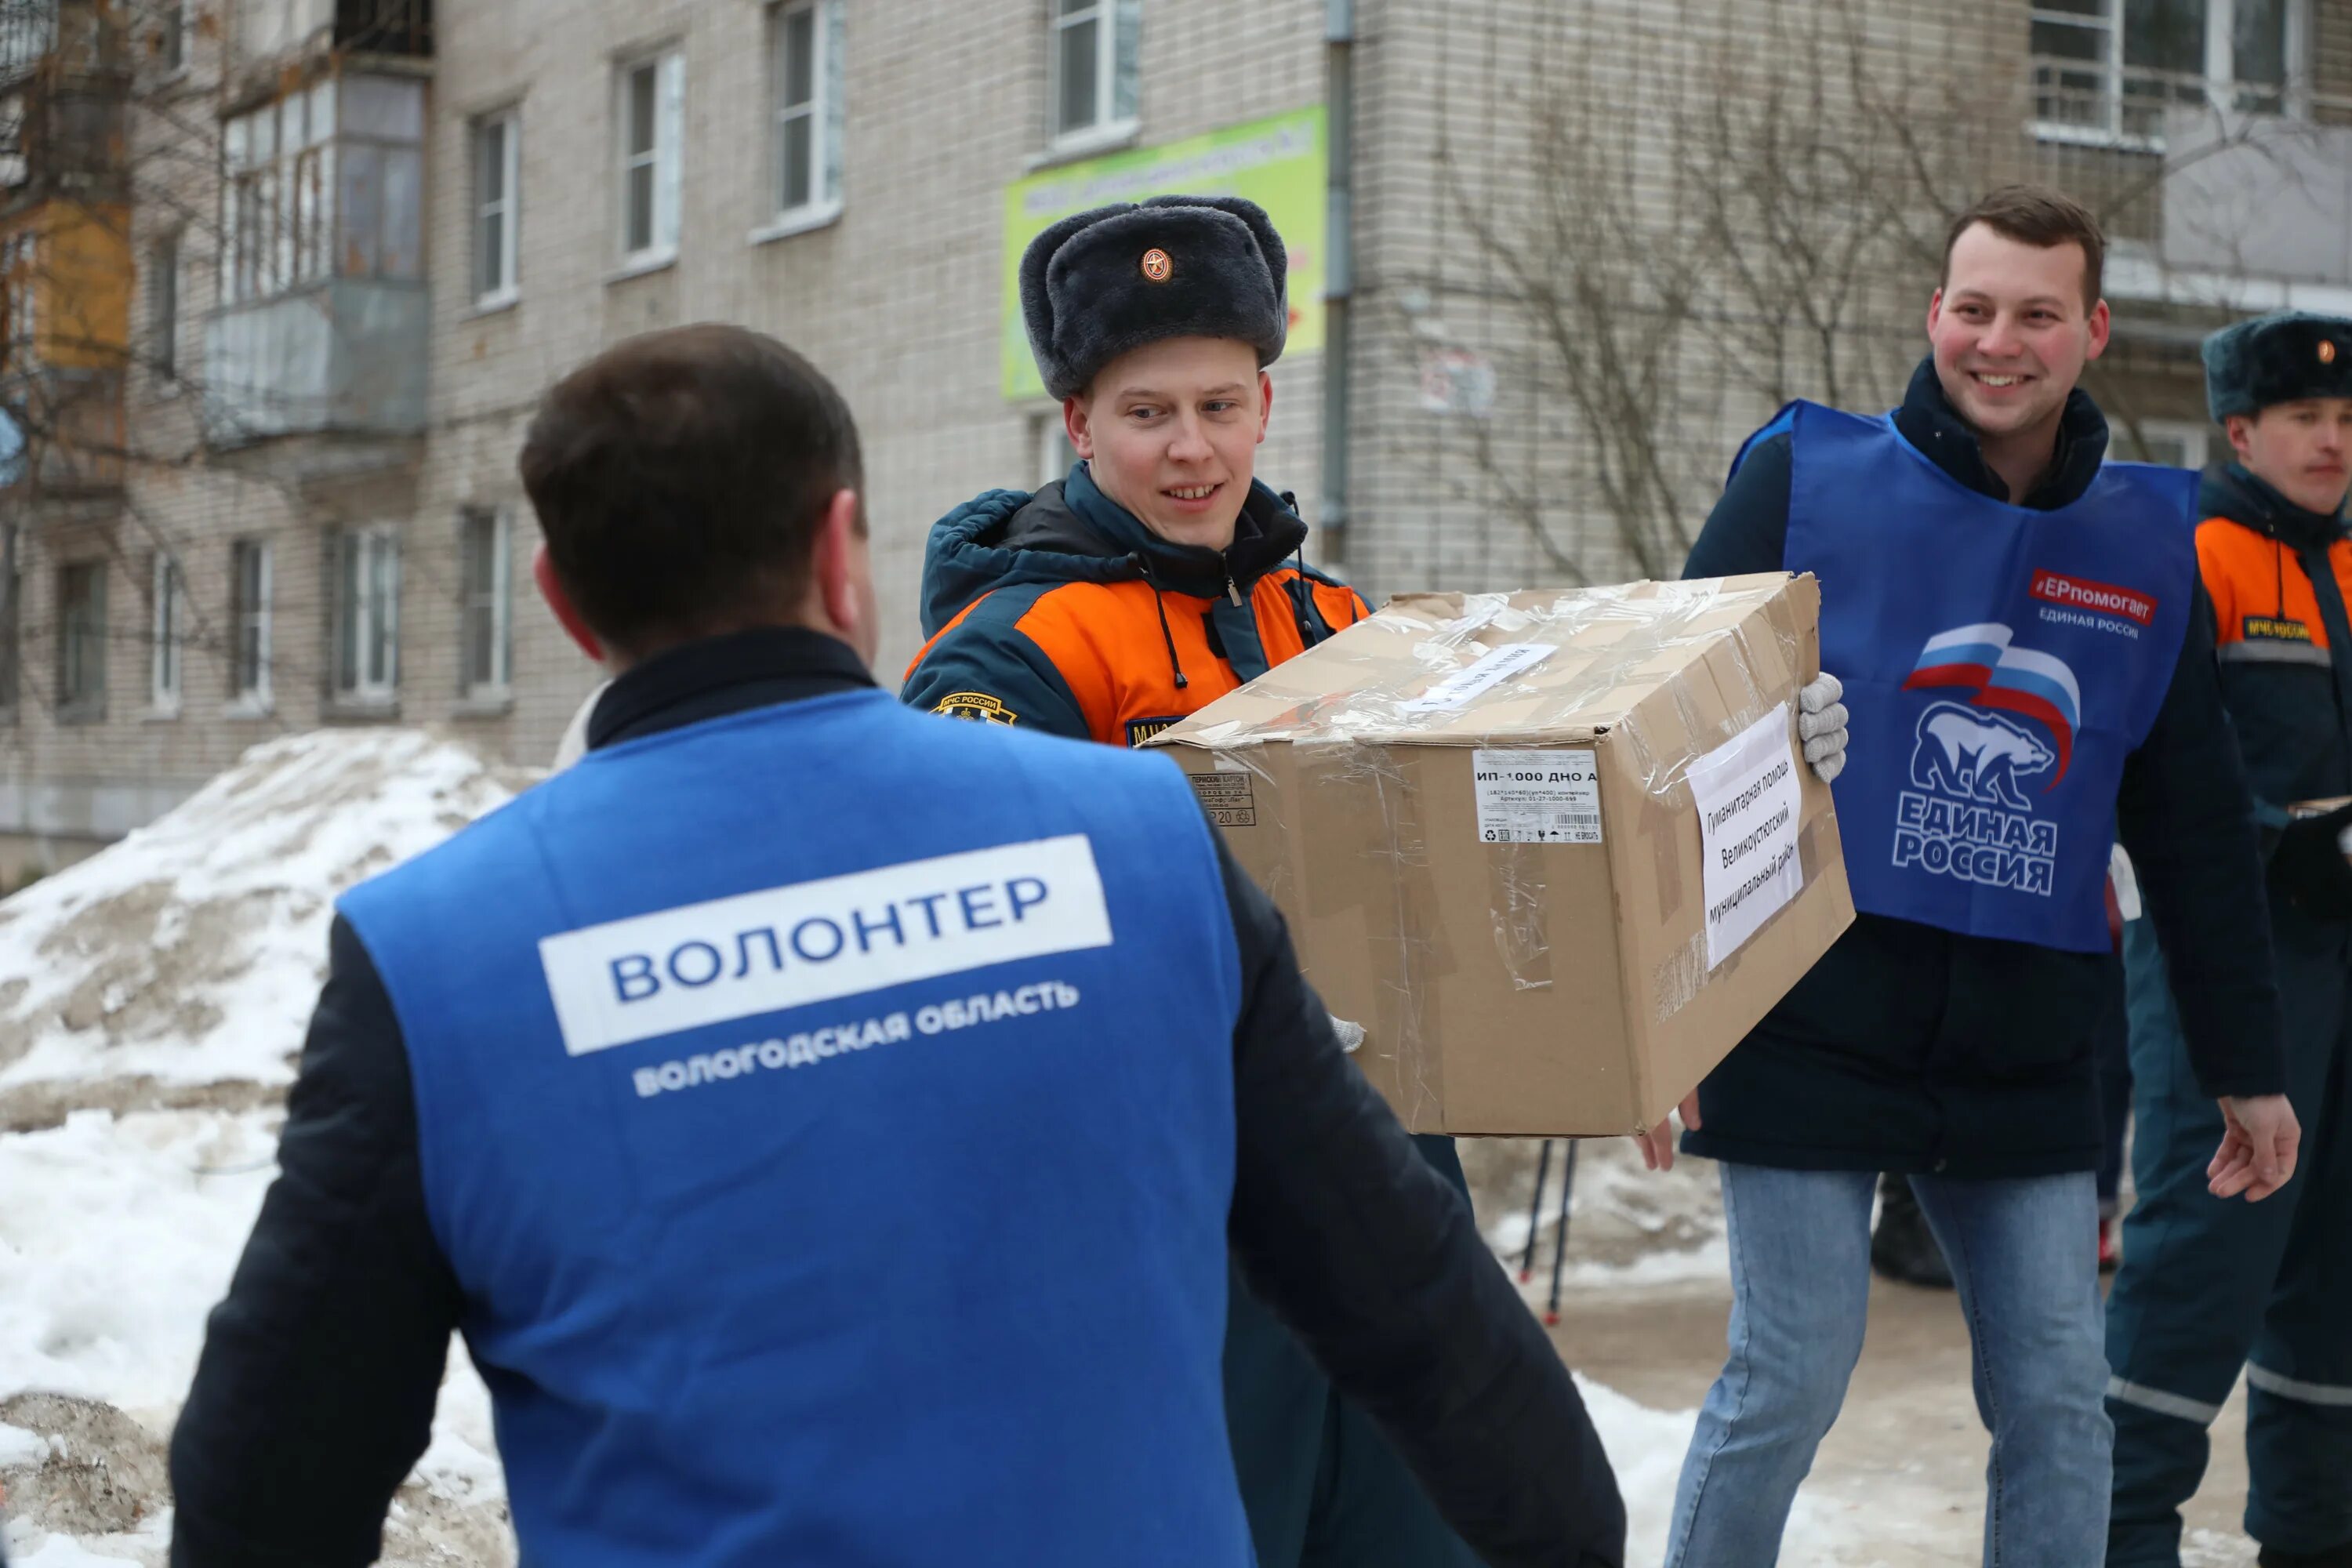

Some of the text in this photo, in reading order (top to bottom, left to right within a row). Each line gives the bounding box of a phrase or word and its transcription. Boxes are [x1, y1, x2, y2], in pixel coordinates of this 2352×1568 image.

[2039, 607, 2139, 640] ЕДИНАЯ РОССИЯ
[943, 695, 996, 710] МЧС РОССИИ
[1548, 772, 1582, 783] ДНО
[1587, 772, 1598, 782] А
[1708, 759, 1789, 837] Гуманитарная помощь
[1218, 811, 1232, 823] 20
[1721, 800, 1789, 869] Великоустюгский
[1896, 790, 2058, 858] ЕДИНАЯ
[1709, 840, 1794, 924] муниципальный район
[1892, 828, 2056, 897] РОССИЯ
[608, 876, 1048, 1005] ВОЛОНТЕР
[632, 980, 1080, 1098] ВОЛОГОДСКАЯ ОБЛАСТЬ
